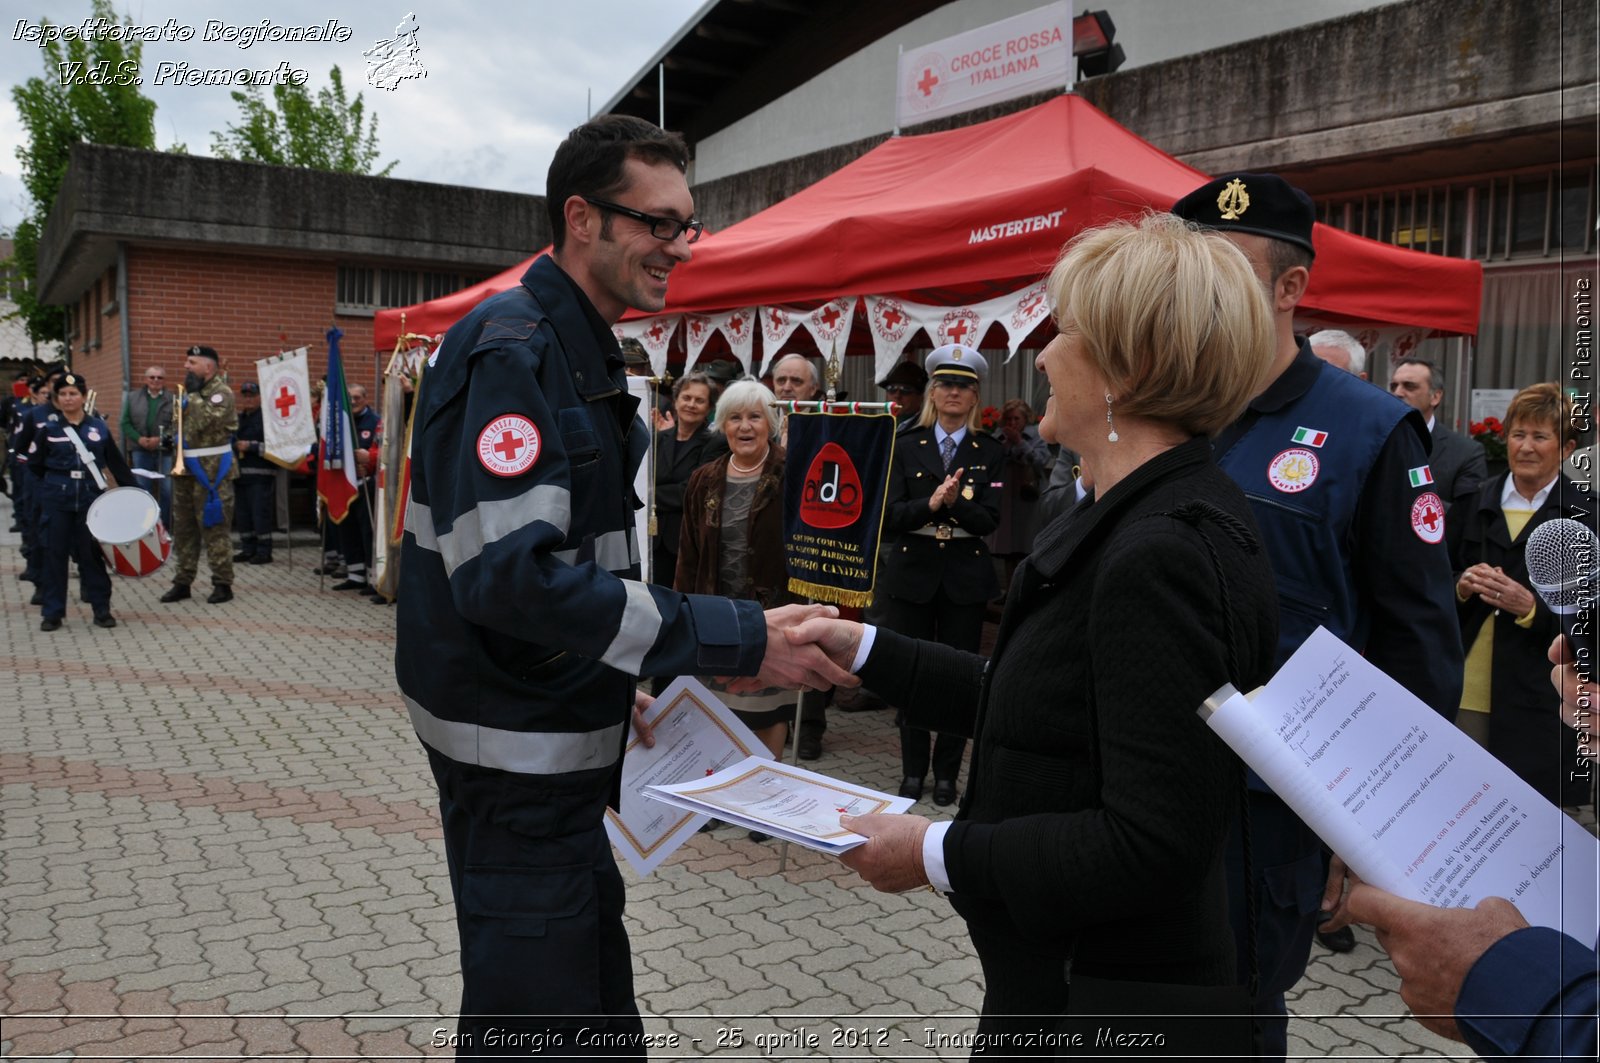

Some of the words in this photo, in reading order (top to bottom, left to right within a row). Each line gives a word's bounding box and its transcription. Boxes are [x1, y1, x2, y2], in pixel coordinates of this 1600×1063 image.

[951, 44, 1002, 72] CROCE
[1006, 27, 1062, 57] ROSSA
[970, 54, 1039, 86] ITALIANA
[816, 537, 860, 552] COMUNALE
[820, 549, 865, 564] BARDESONO
[822, 561, 870, 580] CANAVESE
[1302, 696, 1327, 724] impartita
[1326, 687, 1335, 698] da
[1332, 671, 1350, 689] Padre
[671, 739, 695, 762] GIULIANO
[1308, 740, 1331, 762] leggerà
[1329, 729, 1341, 741] ora
[1339, 717, 1352, 730] una
[1350, 691, 1377, 720] preghiera
[1369, 768, 1379, 777] la
[1378, 743, 1403, 772] pioniera
[1401, 732, 1414, 745] con
[1410, 725, 1420, 734] le
[1325, 781, 1336, 792] del
[1333, 766, 1351, 784] nastro.
[1370, 769, 1393, 797] procede
[1393, 759, 1401, 770] al
[1400, 743, 1418, 762] taglio
[1418, 730, 1429, 744] del
[1371, 815, 1397, 841] Volontario
[1395, 789, 1421, 818] consegna
[1419, 777, 1430, 791] del
[1429, 760, 1448, 781] mazzo
[1447, 752, 1455, 762] di
[1411, 840, 1438, 870] programma
[1436, 827, 1449, 840] con
[1445, 819, 1456, 828] la
[1455, 791, 1484, 820] consegna
[1482, 783, 1491, 791] di
[1444, 855, 1456, 866] dei
[1452, 826, 1482, 854] Volontari
[1479, 798, 1509, 826] Massimo
[1445, 863, 1465, 885] attestati
[1463, 854, 1472, 863] di
[1470, 814, 1510, 854] benemerenza
[1509, 805, 1518, 814] ai
[1457, 854, 1488, 889] associazioni
[1487, 819, 1521, 854] intervenute
[1514, 879, 1531, 897] delle
[1530, 841, 1565, 879] delegazioni
